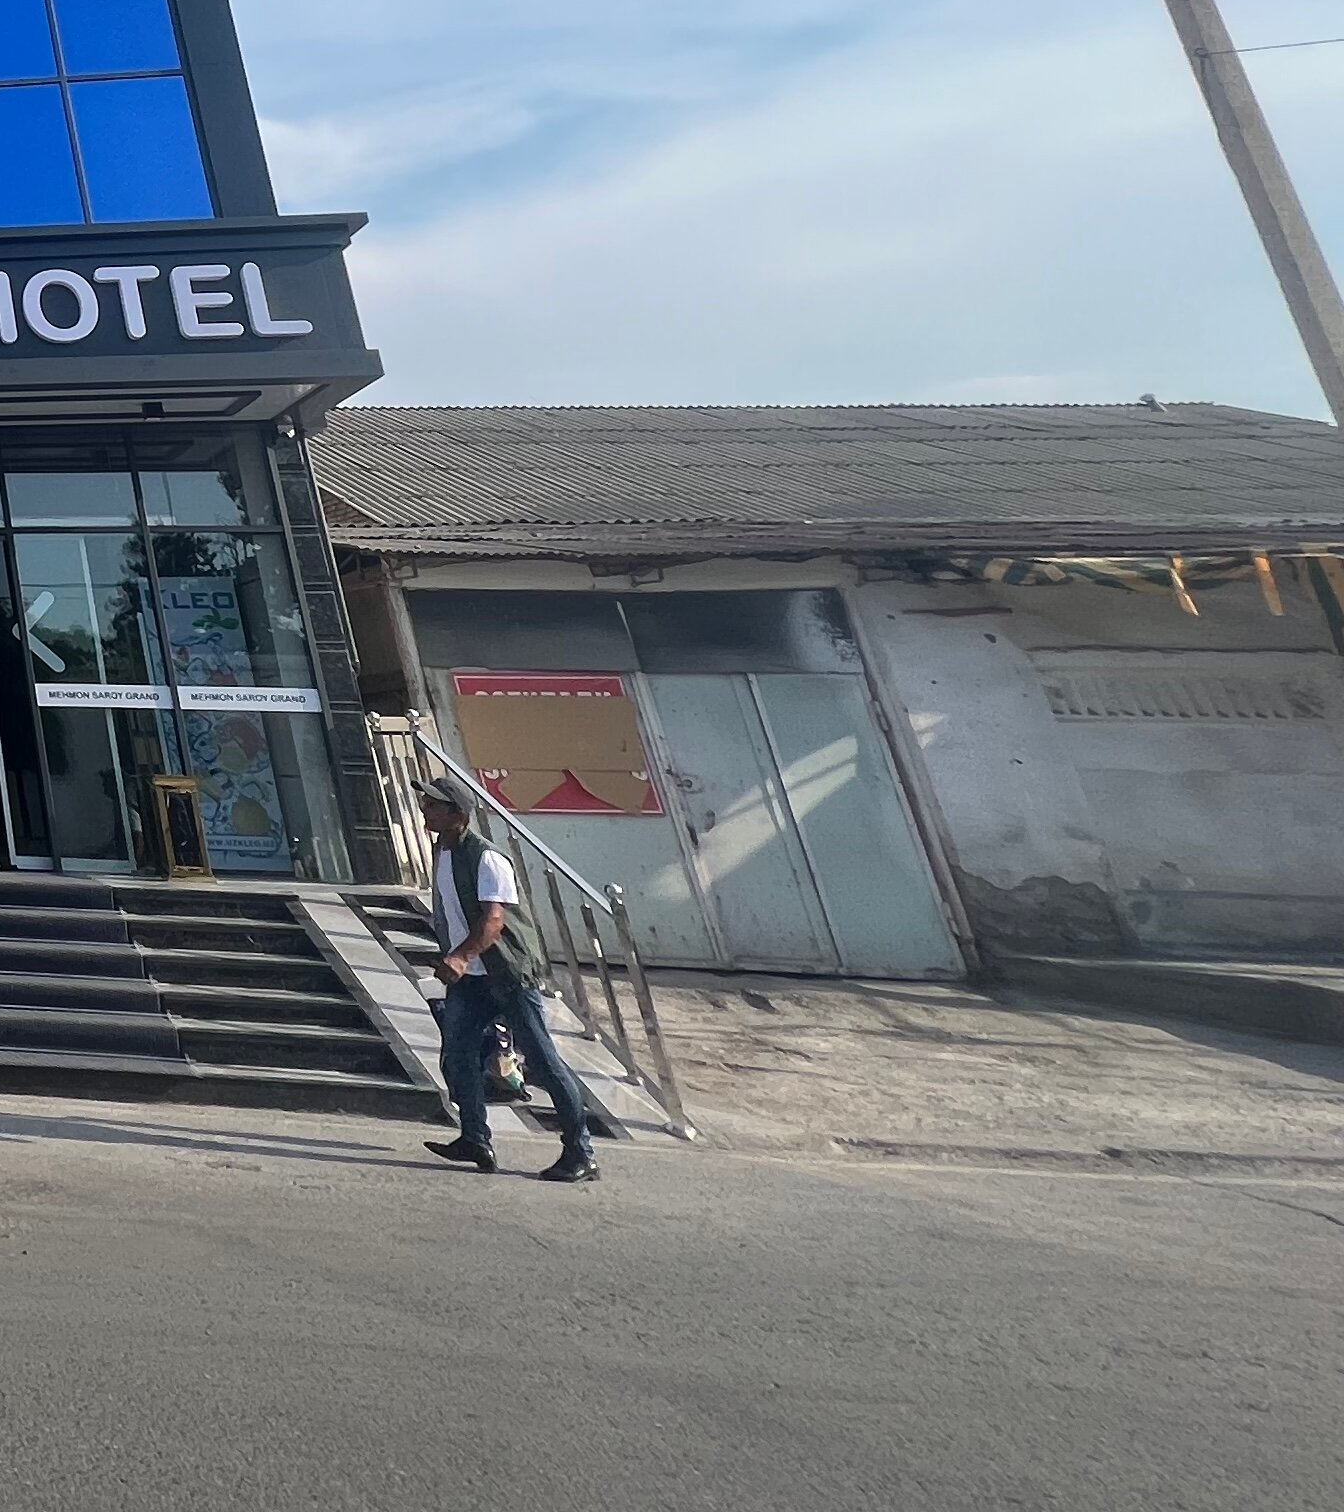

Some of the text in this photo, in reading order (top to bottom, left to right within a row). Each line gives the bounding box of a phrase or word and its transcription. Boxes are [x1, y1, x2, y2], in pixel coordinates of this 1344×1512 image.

[48, 691, 160, 701] MEHMON SAROY GRAND
[190, 692, 306, 704] MEHMON SAROY GRAND
